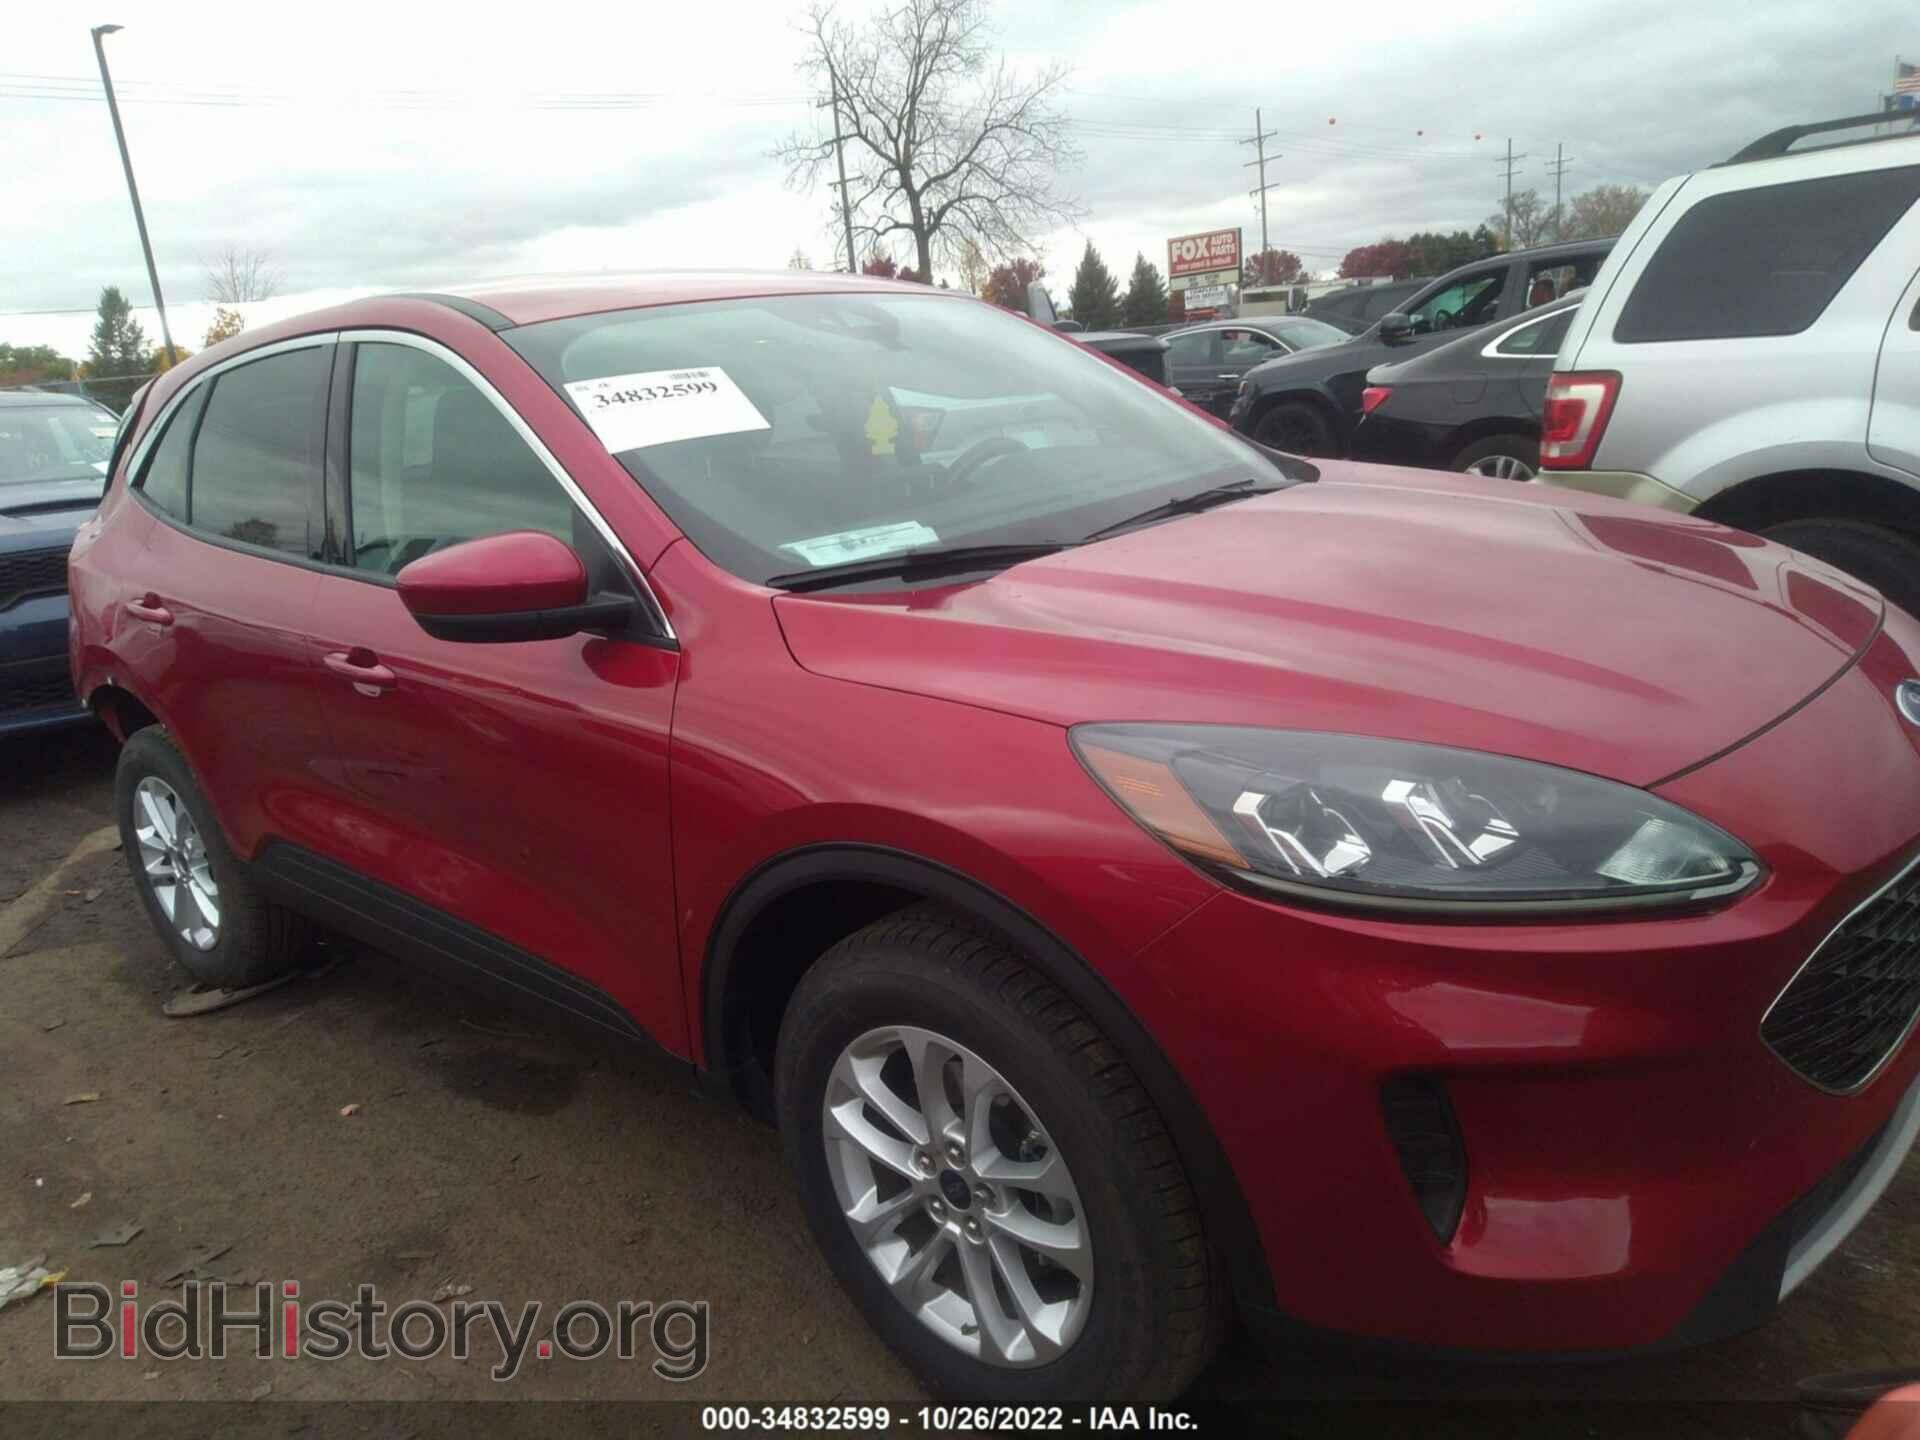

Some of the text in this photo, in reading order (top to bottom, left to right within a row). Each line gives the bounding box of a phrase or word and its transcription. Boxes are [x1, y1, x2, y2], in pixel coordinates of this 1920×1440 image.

[1211, 233, 1233, 245] AUTO
[1171, 238, 1210, 262] FOX
[1211, 242, 1236, 256] PARTS
[592, 381, 718, 409] 34832599
